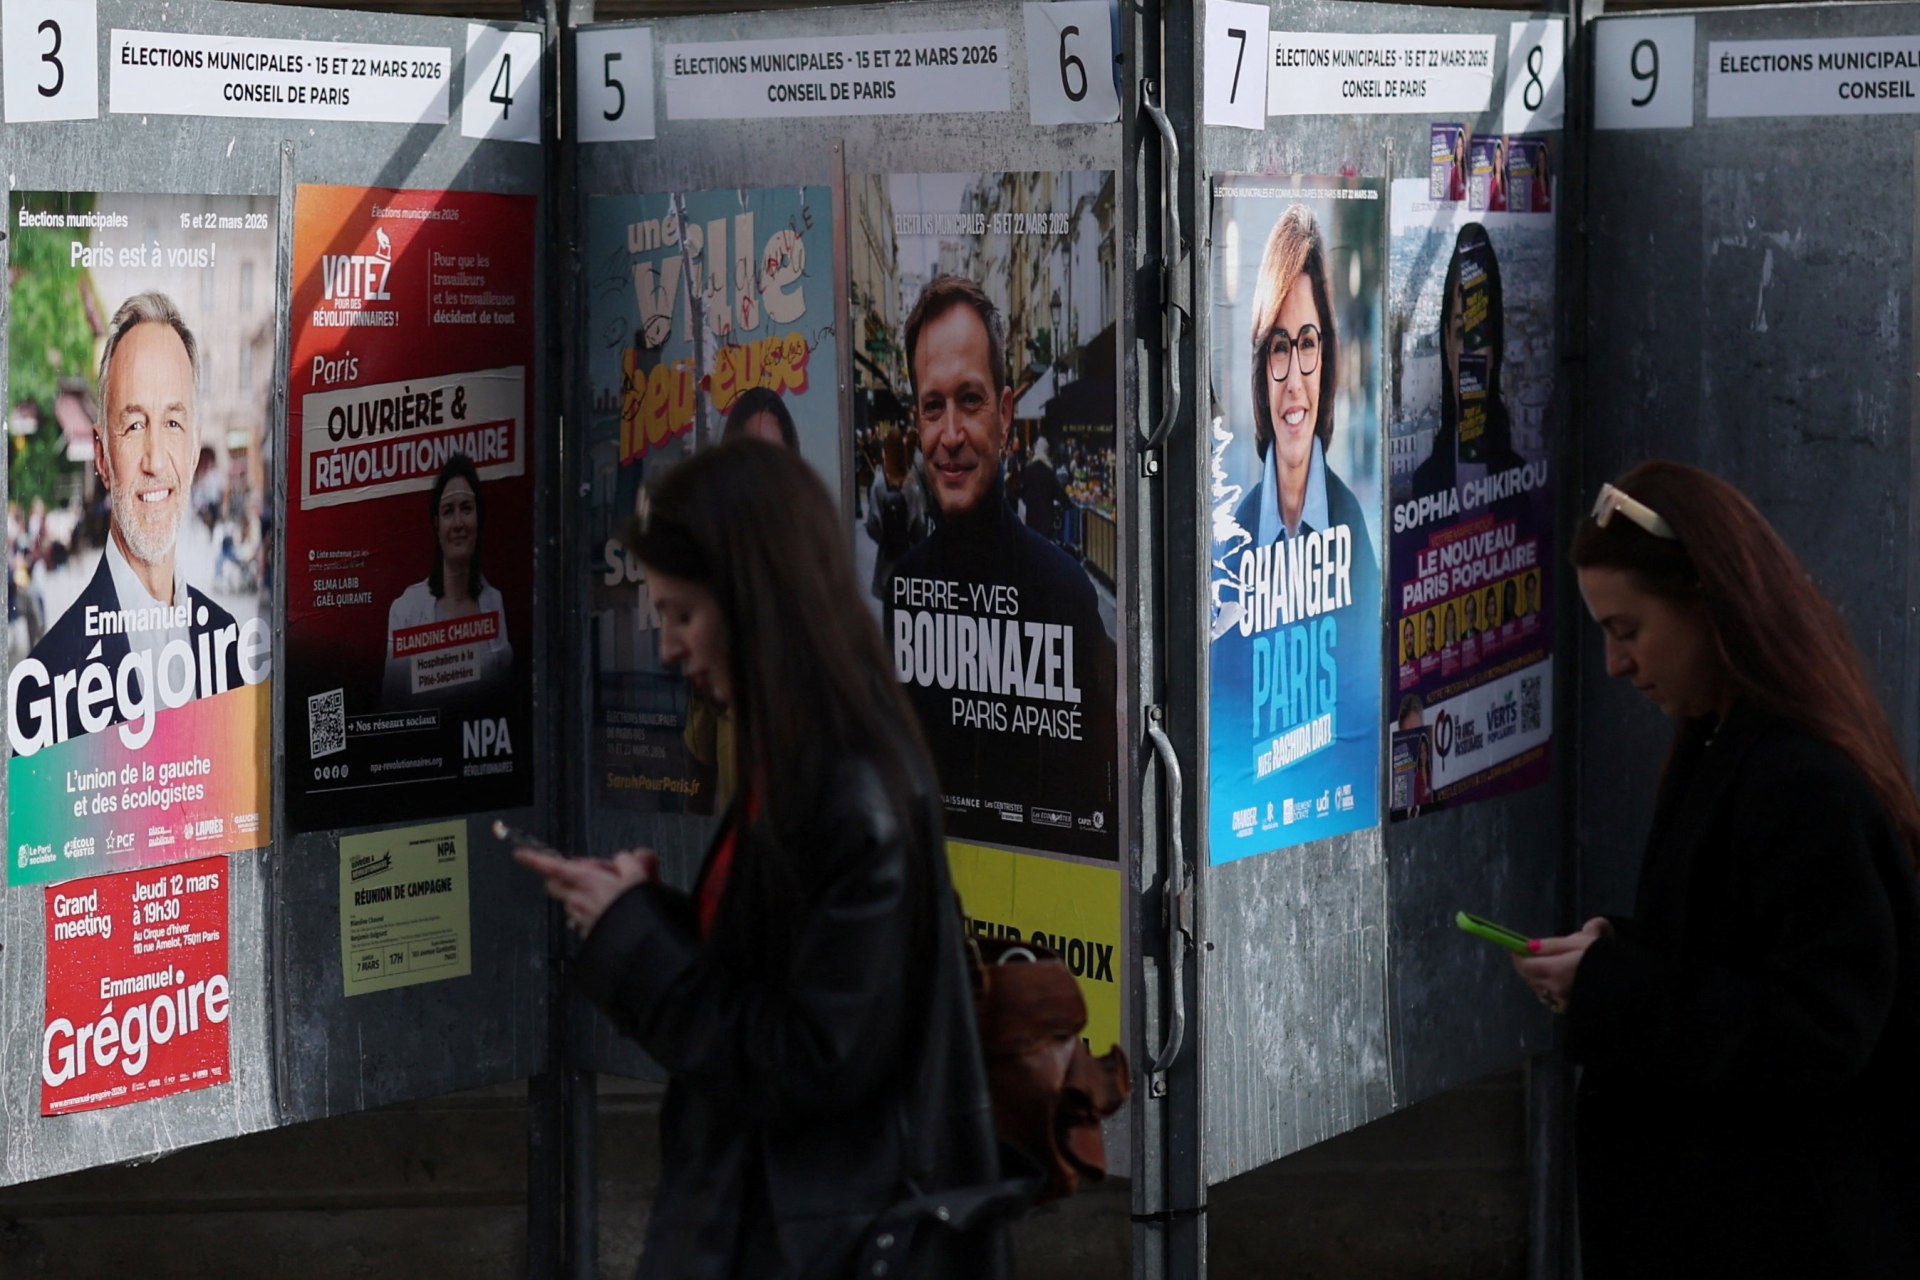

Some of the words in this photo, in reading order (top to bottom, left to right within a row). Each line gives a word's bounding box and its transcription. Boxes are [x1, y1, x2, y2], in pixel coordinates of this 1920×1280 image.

[36, 18, 65, 98] 3
[121, 41, 203, 68] ÉLECTIONS
[207, 51, 303, 73] MUNICIPALES
[315, 57, 328, 74] 15
[332, 57, 348, 75] ET
[351, 59, 366, 76] 22
[370, 60, 408, 78] MARS
[411, 62, 442, 79] 2026
[675, 54, 748, 76] ÉLECTIONS
[751, 52, 844, 73] MUNICIPALES
[856, 50, 870, 68] 15
[874, 50, 891, 68] ET
[895, 49, 911, 67] 22
[915, 47, 958, 66] MARS
[962, 45, 998, 65] 2026
[1059, 25, 1088, 102] 6
[1227, 28, 1247, 104] 7
[1275, 43, 1330, 67] ÉLECTIONS
[1332, 48, 1397, 68] MUNICIPALES
[1404, 50, 1412, 67] 15
[1415, 50, 1426, 67] ET
[1428, 50, 1438, 67] 22
[1440, 50, 1466, 67] MARS
[1468, 50, 1488, 67] 2026
[1720, 52, 1813, 74] ÉLECTIONS
[489, 53, 514, 120] 4
[603, 52, 626, 122] 5
[1523, 44, 1544, 112] 8
[1630, 39, 1660, 107] 9
[223, 83, 284, 103] CONSEIL
[288, 86, 306, 103] DE
[310, 87, 350, 105] PARIS
[767, 83, 827, 103] CONSEIL
[830, 82, 850, 100] DE
[853, 81, 896, 100] PARIS
[1342, 80, 1382, 98] CONSEIL
[1385, 80, 1397, 97] DE
[1400, 80, 1427, 97] PARIS
[1838, 81, 1915, 100] CONSEIL
[19, 207, 64, 227] Élections
[66, 211, 128, 232] municipales
[180, 213, 190, 229] 15
[193, 213, 203, 229] et
[205, 213, 217, 229] 22
[219, 216, 243, 229] mars
[245, 213, 268, 229] 2026
[371, 204, 401, 218] Élections
[442, 209, 459, 220] 2026
[935, 213, 985, 235] MUNICIPALES
[993, 213, 1001, 235] 15
[1003, 213, 1013, 235] ET
[1014, 213, 1024, 235] 22
[1026, 213, 1048, 235] MARS
[1049, 213, 1070, 235] 2026
[627, 214, 680, 255] une
[71, 241, 114, 268] Paris
[119, 245, 146, 267] est
[151, 240, 162, 267] à
[433, 252, 455, 267] Pour
[458, 254, 475, 269] que
[477, 254, 489, 267] les
[322, 254, 392, 300] VOTEZ
[433, 272, 486, 286] travailleurs
[334, 299, 350, 309] POUR
[350, 299, 362, 309] DES
[433, 292, 443, 305] et
[445, 291, 458, 305] les
[460, 291, 515, 306] travailleuses
[313, 306, 394, 327] RÉVOLUTIONNAIRES
[433, 309, 477, 324] décident
[480, 309, 491, 324] de
[493, 310, 515, 324] tout
[311, 350, 359, 386] Paris
[327, 386, 443, 442] OUVRIÈRE
[450, 385, 467, 421] &
[619, 332, 808, 467] heueuse
[315, 426, 508, 490] RÉVOLUTIONNAIRE
[1394, 487, 1461, 533] SOPHIA
[1462, 459, 1548, 511] CHIKIROU
[1418, 549, 1438, 579] LE
[1440, 523, 1516, 571] NOUVEAU
[313, 578, 337, 591] SELMA
[338, 576, 359, 590] LABIB
[1239, 523, 1352, 637] CHANGER
[1403, 572, 1449, 610] PARIS
[1452, 541, 1537, 592] POPULAIRE
[316, 592, 336, 607] GAËL
[336, 592, 372, 608] QUIRANTE
[894, 576, 1019, 616] PIERRE-YVES
[85, 597, 192, 636] Emmanuel
[396, 629, 446, 652] BLANDINE
[447, 617, 497, 641] CHAUVEL
[418, 653, 459, 671] Hospitalière
[467, 651, 474, 662] la
[894, 608, 1082, 704] BOURNAZEL
[8, 605, 272, 757] Grégoire
[418, 668, 474, 687] Pitié-Salpêtrière
[1253, 616, 1337, 738] PARIS
[356, 720, 372, 733] Nos
[373, 719, 404, 731] réseaux
[406, 715, 437, 727] sociaux
[952, 697, 1008, 732] PARIS
[1011, 704, 1083, 741] APAISÉ
[1487, 701, 1516, 731] VERTS
[463, 717, 513, 760] NPA
[1273, 723, 1311, 770] RACHIDA
[1312, 712, 1332, 751] DATI
[121, 765, 138, 784] de
[142, 763, 155, 782] la
[159, 755, 211, 786] gauche
[370, 757, 443, 773] npa-revolutionnaires.org
[74, 797, 88, 817] et
[92, 792, 117, 814] des
[121, 782, 204, 810] écologistes
[607, 772, 701, 797] SarahPourParis.fr
[1316, 790, 1329, 812] udi
[116, 833, 135, 848] PCF
[437, 841, 456, 857] NPA
[54, 888, 98, 918] Grand
[132, 876, 167, 903] Jeudi
[171, 874, 183, 895] 12
[186, 873, 219, 894] mars
[355, 888, 392, 906] RÉUNION
[394, 884, 405, 900] DE
[408, 877, 452, 897] CAMPAGNE
[54, 913, 112, 941] meeting
[133, 904, 140, 926] à
[144, 898, 180, 923] 19h30
[133, 931, 143, 942] Au
[143, 927, 165, 941] Cirque
[143, 943, 155, 952] rue
[184, 932, 202, 946] 75011
[202, 930, 220, 942] Paris
[390, 952, 403, 965] 17H
[101, 964, 173, 999] Emmanuel
[42, 970, 230, 1087] Grégoire
